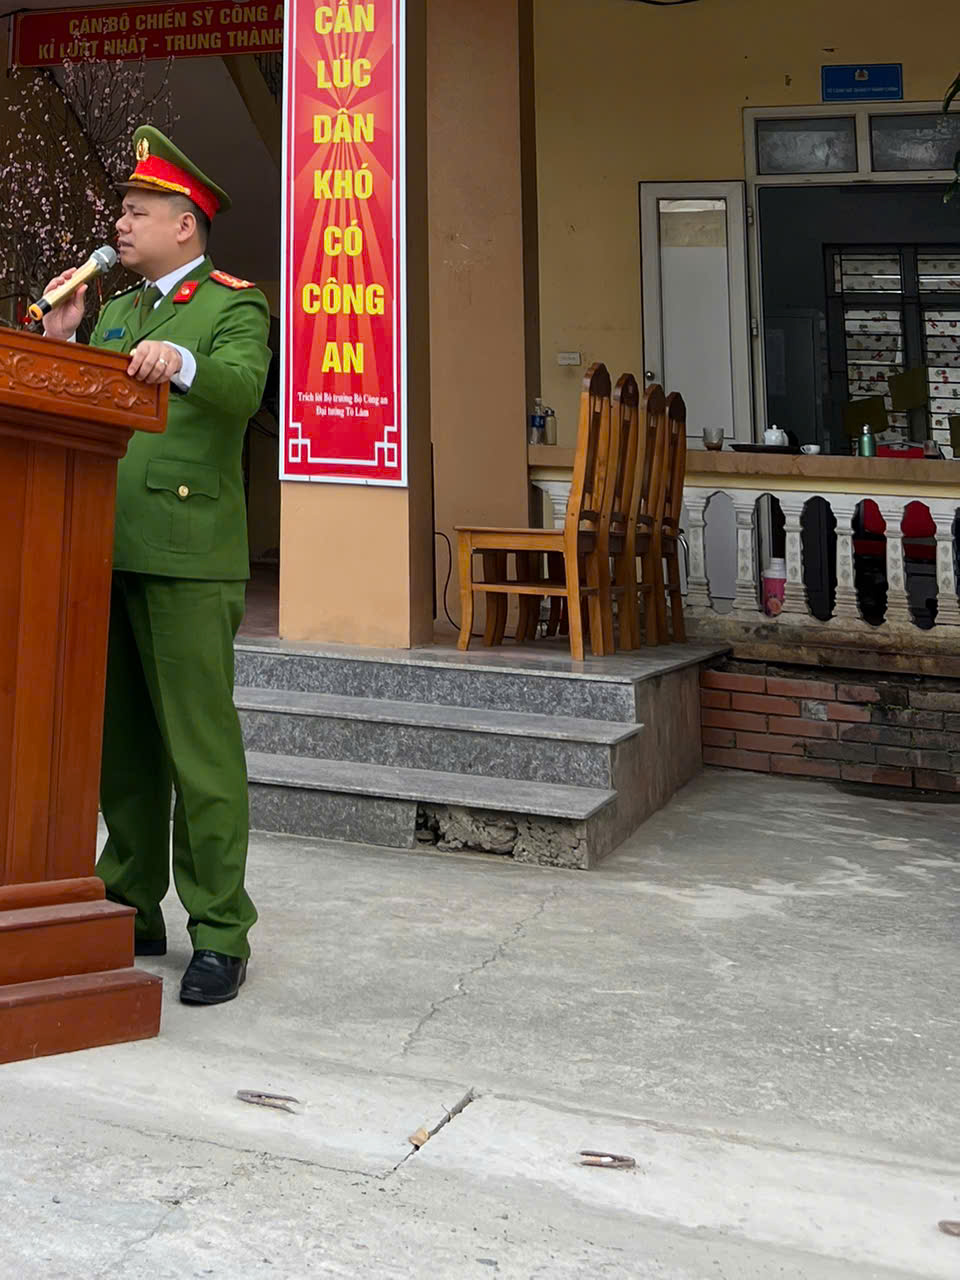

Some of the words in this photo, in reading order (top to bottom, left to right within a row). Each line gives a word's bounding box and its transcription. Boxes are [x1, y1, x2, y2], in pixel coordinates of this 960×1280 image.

[69, 16, 103, 35] CÁN
[135, 7, 187, 30] CHIẾN
[192, 7, 213, 26] SỸ
[219, 4, 268, 24] CÔNG
[103, 31, 148, 55] NHẤT
[164, 32, 222, 52] TRUNG
[317, 50, 371, 89] LÚC
[314, 108, 374, 144] DÂN
[314, 160, 372, 200] KHÓ
[324, 219, 362, 256] CÓ
[303, 277, 384, 314] CÔNG
[322, 342, 363, 373] AN
[297, 392, 315, 402] Trích
[324, 392, 333, 403] Bộ
[354, 393, 363, 405] Bộ
[363, 394, 380, 406] Công
